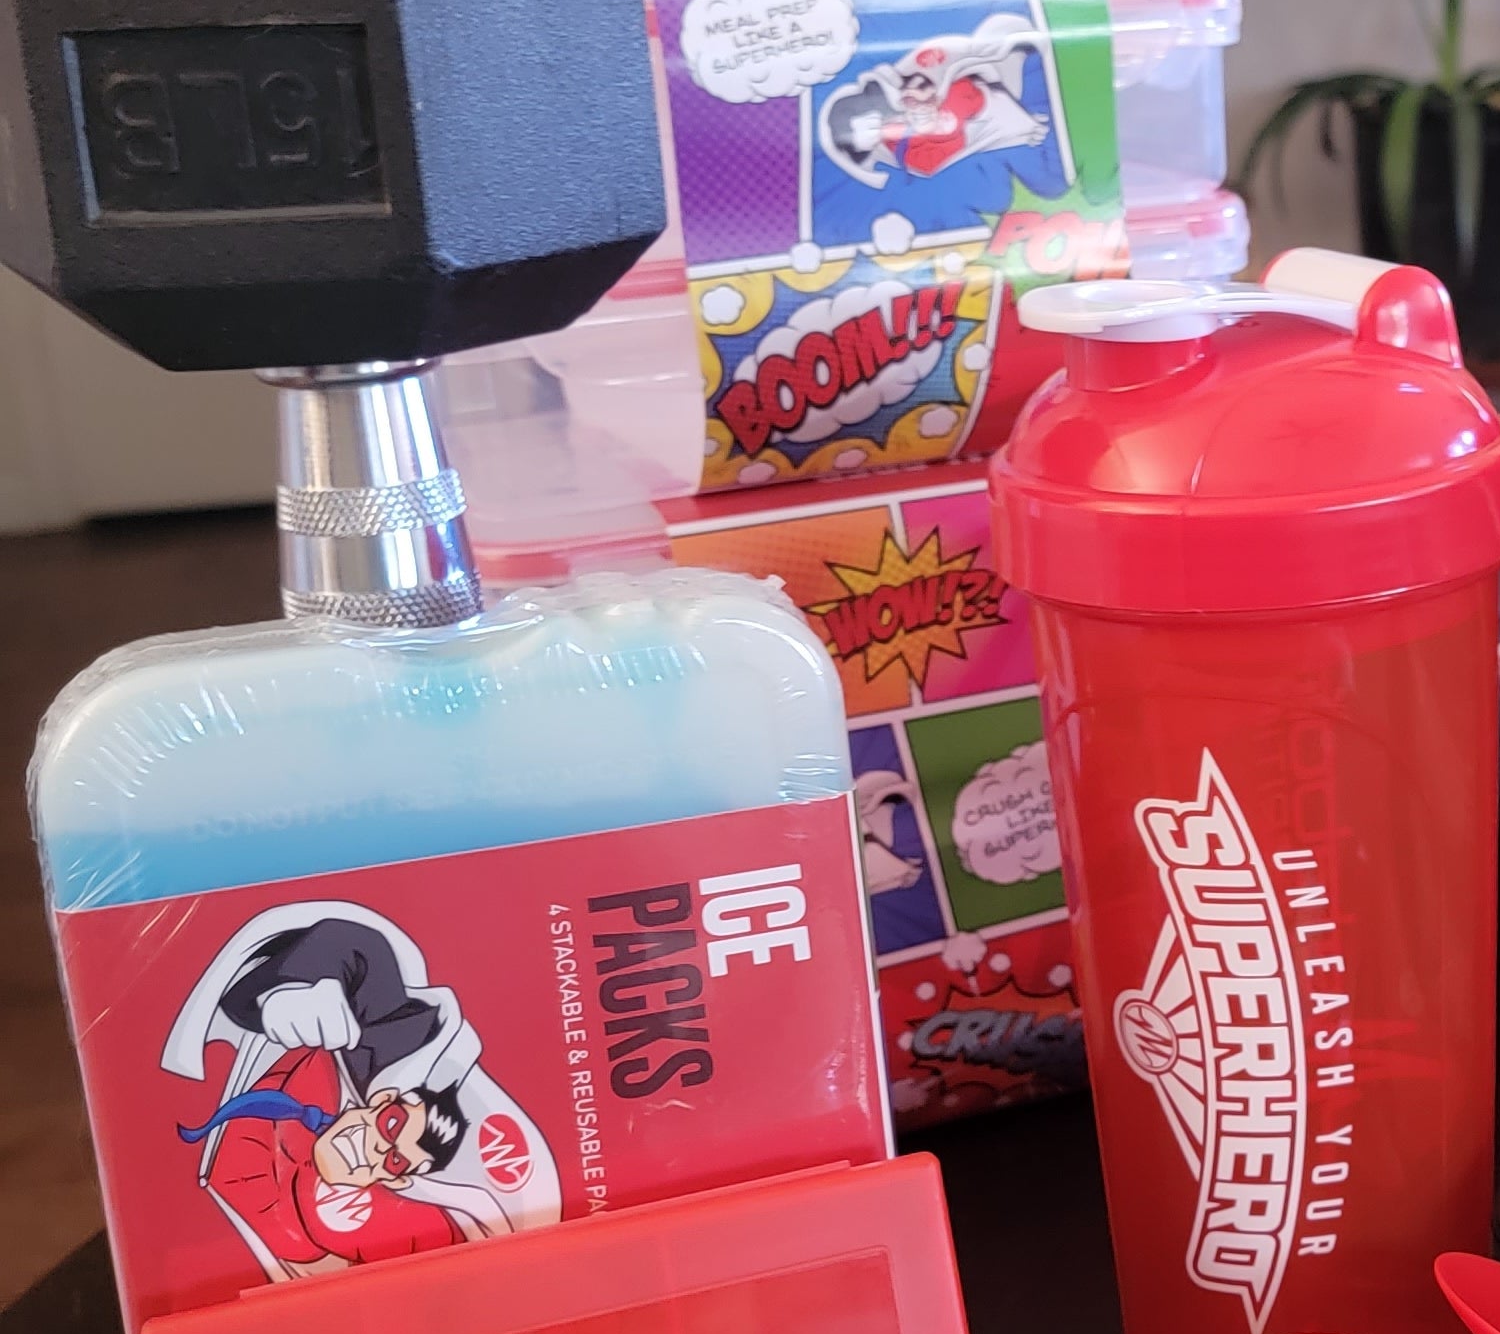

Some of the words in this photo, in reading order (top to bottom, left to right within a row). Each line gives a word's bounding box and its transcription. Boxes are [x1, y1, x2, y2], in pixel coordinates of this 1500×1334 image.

[705, 14, 761, 37] MEAL
[733, 25, 783, 49] LIKE
[790, 21, 803, 34] A
[717, 280, 966, 457] BOOM!!!
[548, 904, 570, 917] 4
[698, 863, 812, 978] ICE
[1271, 848, 1356, 1089] UNLEASH
[550, 920, 587, 1045] STACKABLE
[587, 882, 714, 1099] PACKS
[567, 1048, 590, 1066] &
[1147, 795, 1297, 1301] SUPERHERO
[569, 1069, 606, 1183] REUSABLE
[1296, 1123, 1354, 1257] YOUR
